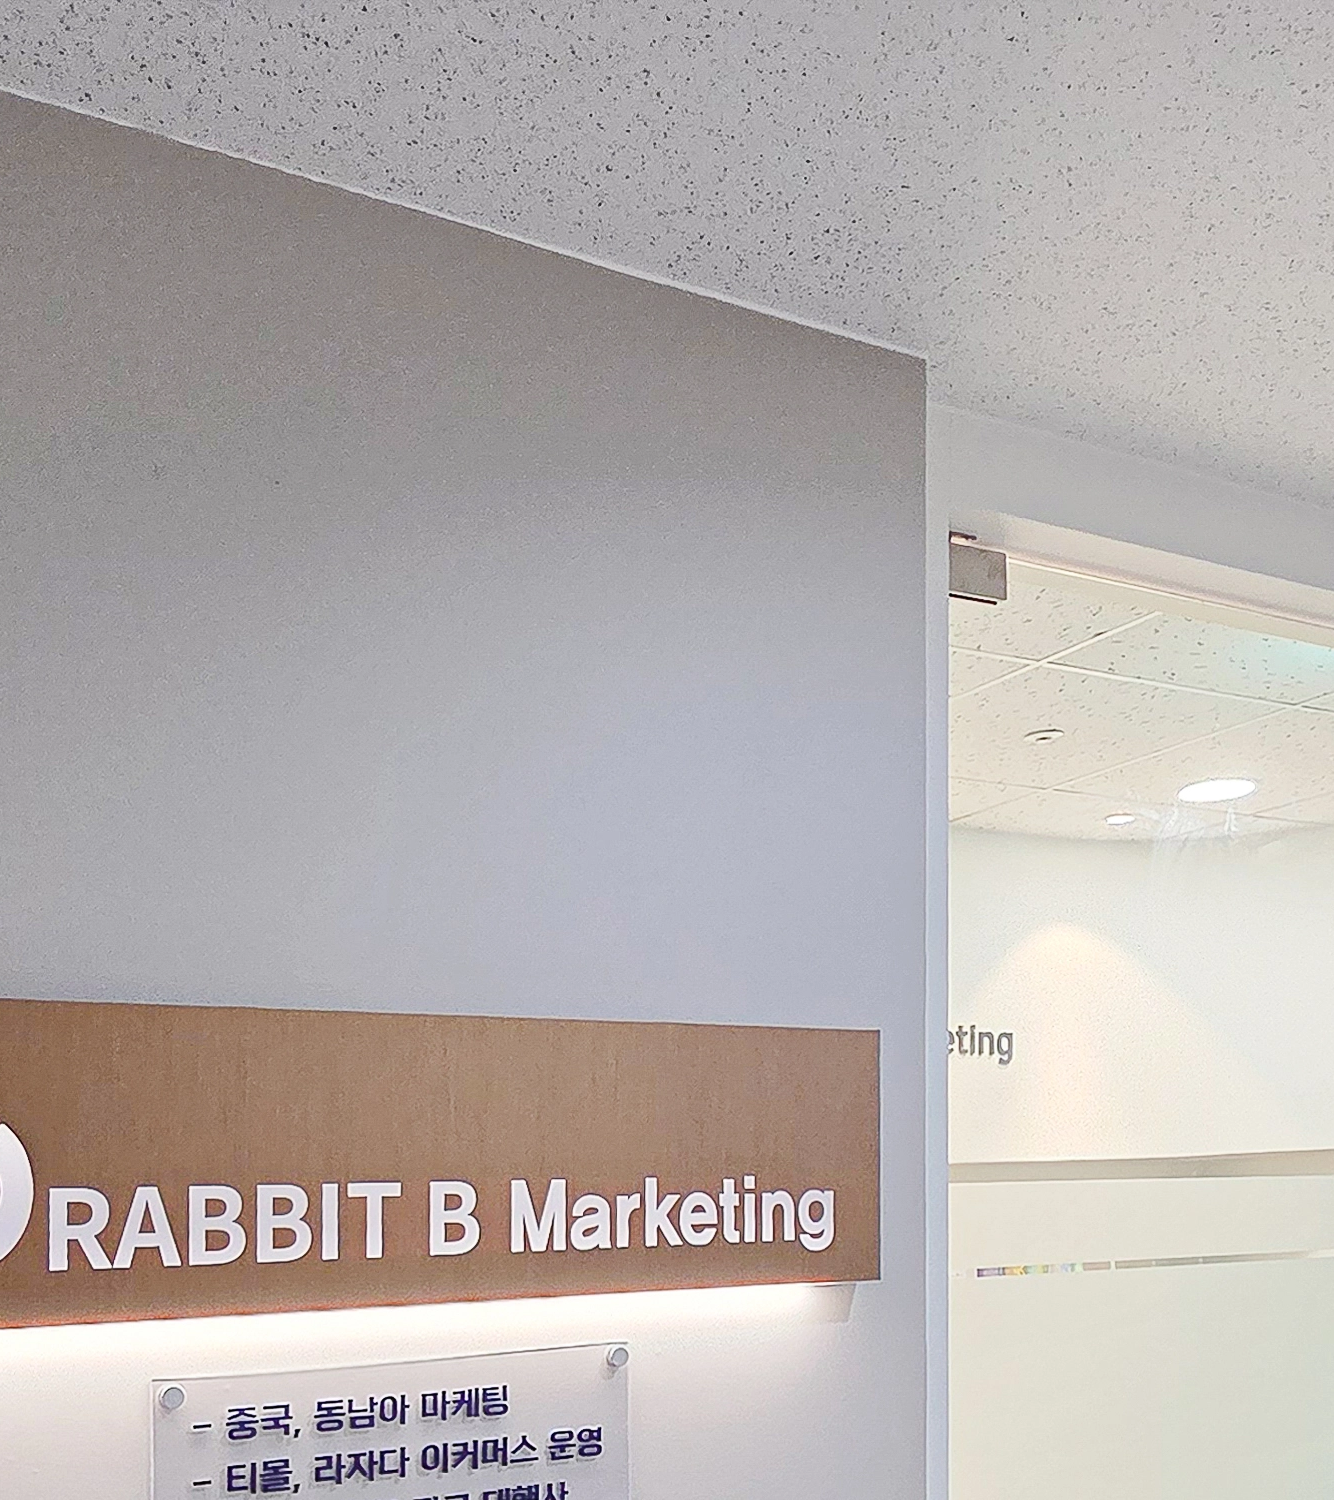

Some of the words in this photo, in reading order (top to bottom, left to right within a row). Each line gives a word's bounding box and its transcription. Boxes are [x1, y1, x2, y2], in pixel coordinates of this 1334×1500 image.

[47, 1180, 402, 1273] RABBIT
[429, 1180, 481, 1258] B
[509, 1175, 836, 1253] Marketing
[225, 1403, 301, 1441] 중국,
[313, 1394, 411, 1432] 동남아
[420, 1384, 509, 1421] 마케팅
[226, 1458, 301, 1494] 티몰,
[314, 1446, 411, 1485] 라자다
[420, 1435, 540, 1474] 이커머스
[547, 1426, 603, 1461] 운영
